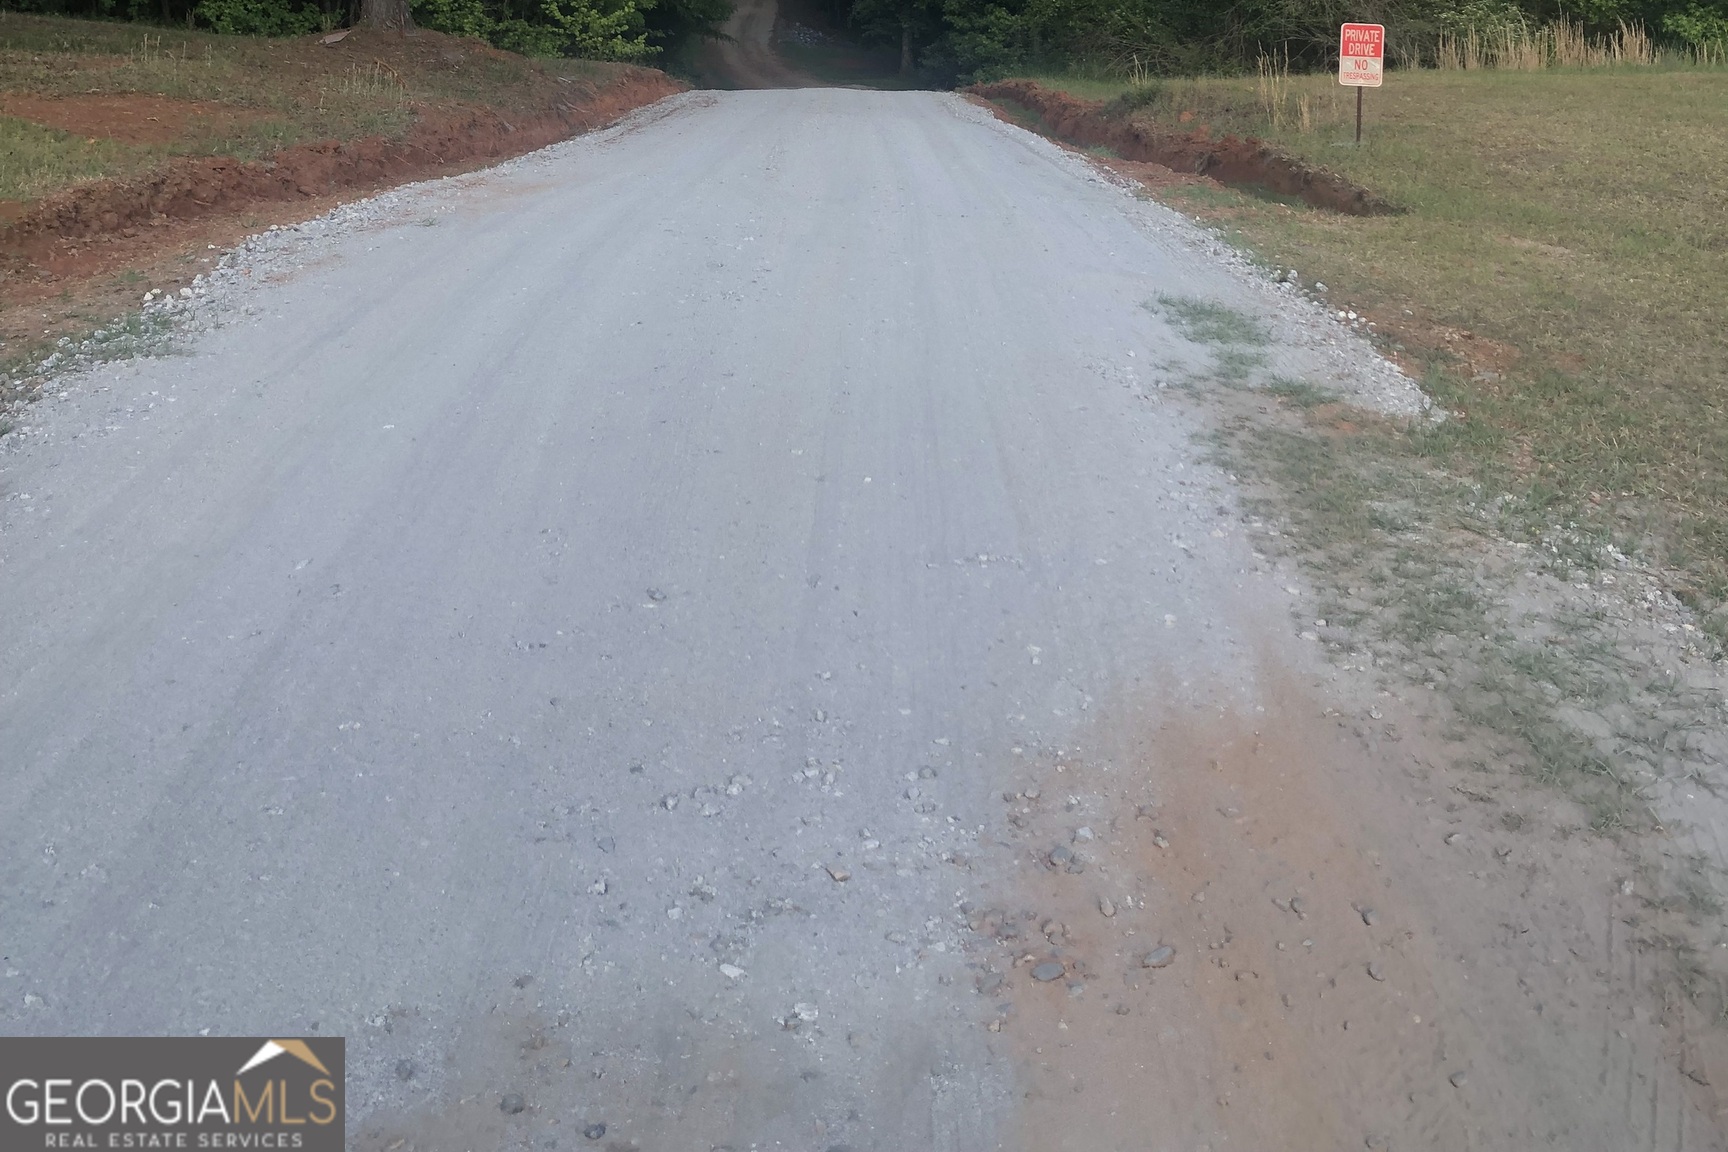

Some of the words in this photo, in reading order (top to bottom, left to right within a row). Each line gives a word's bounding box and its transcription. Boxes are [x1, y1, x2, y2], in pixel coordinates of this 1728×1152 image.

[1345, 29, 1380, 42] PRIVATE
[1348, 43, 1375, 56] DRIVE
[1354, 59, 1368, 70] NO
[1343, 71, 1379, 80] TRESPASSING
